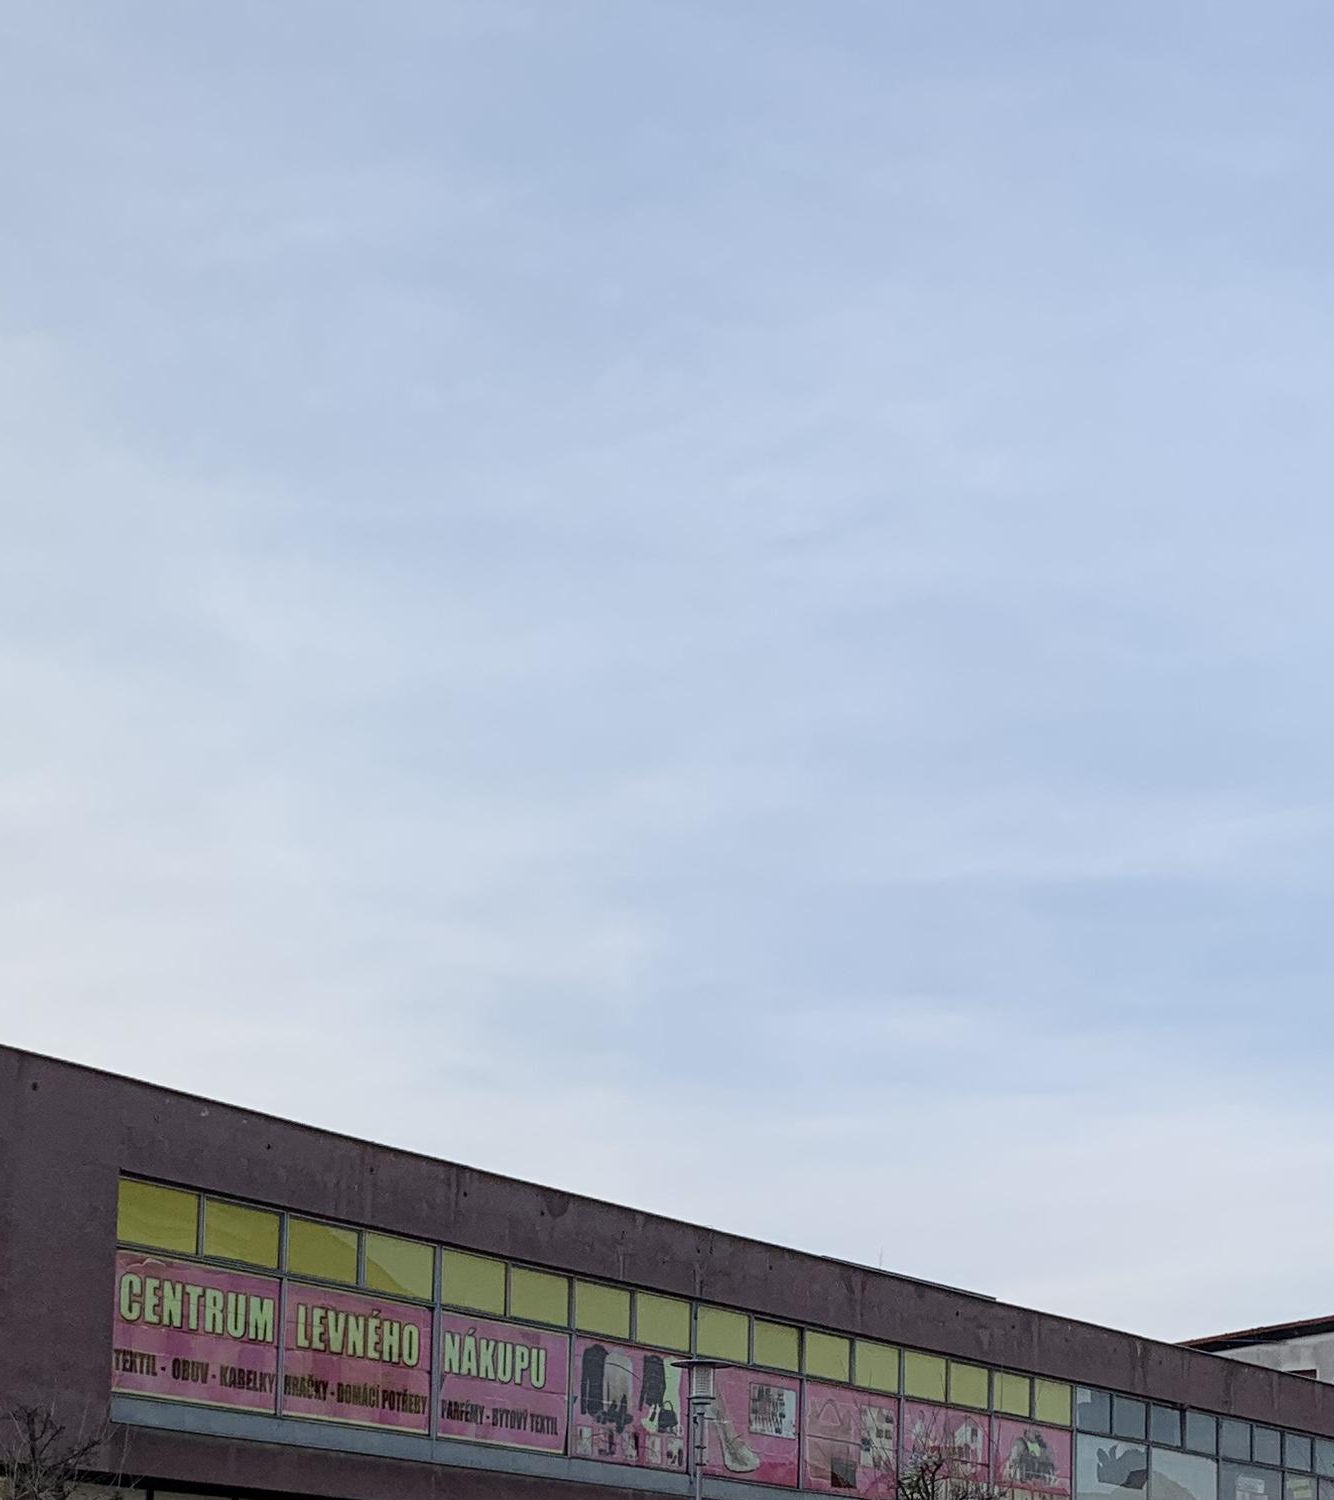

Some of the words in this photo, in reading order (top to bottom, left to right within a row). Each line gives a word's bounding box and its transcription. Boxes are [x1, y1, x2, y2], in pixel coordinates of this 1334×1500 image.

[119, 1272, 275, 1343] CENTRUM
[296, 1309, 420, 1368] LEVNÉHO
[443, 1327, 547, 1390] NÁKUPU
[172, 1358, 209, 1384] OBUV
[220, 1365, 276, 1394] KABELKY
[381, 1388, 428, 1415] POTŘEBY
[530, 1413, 558, 1436] TEXTIL
